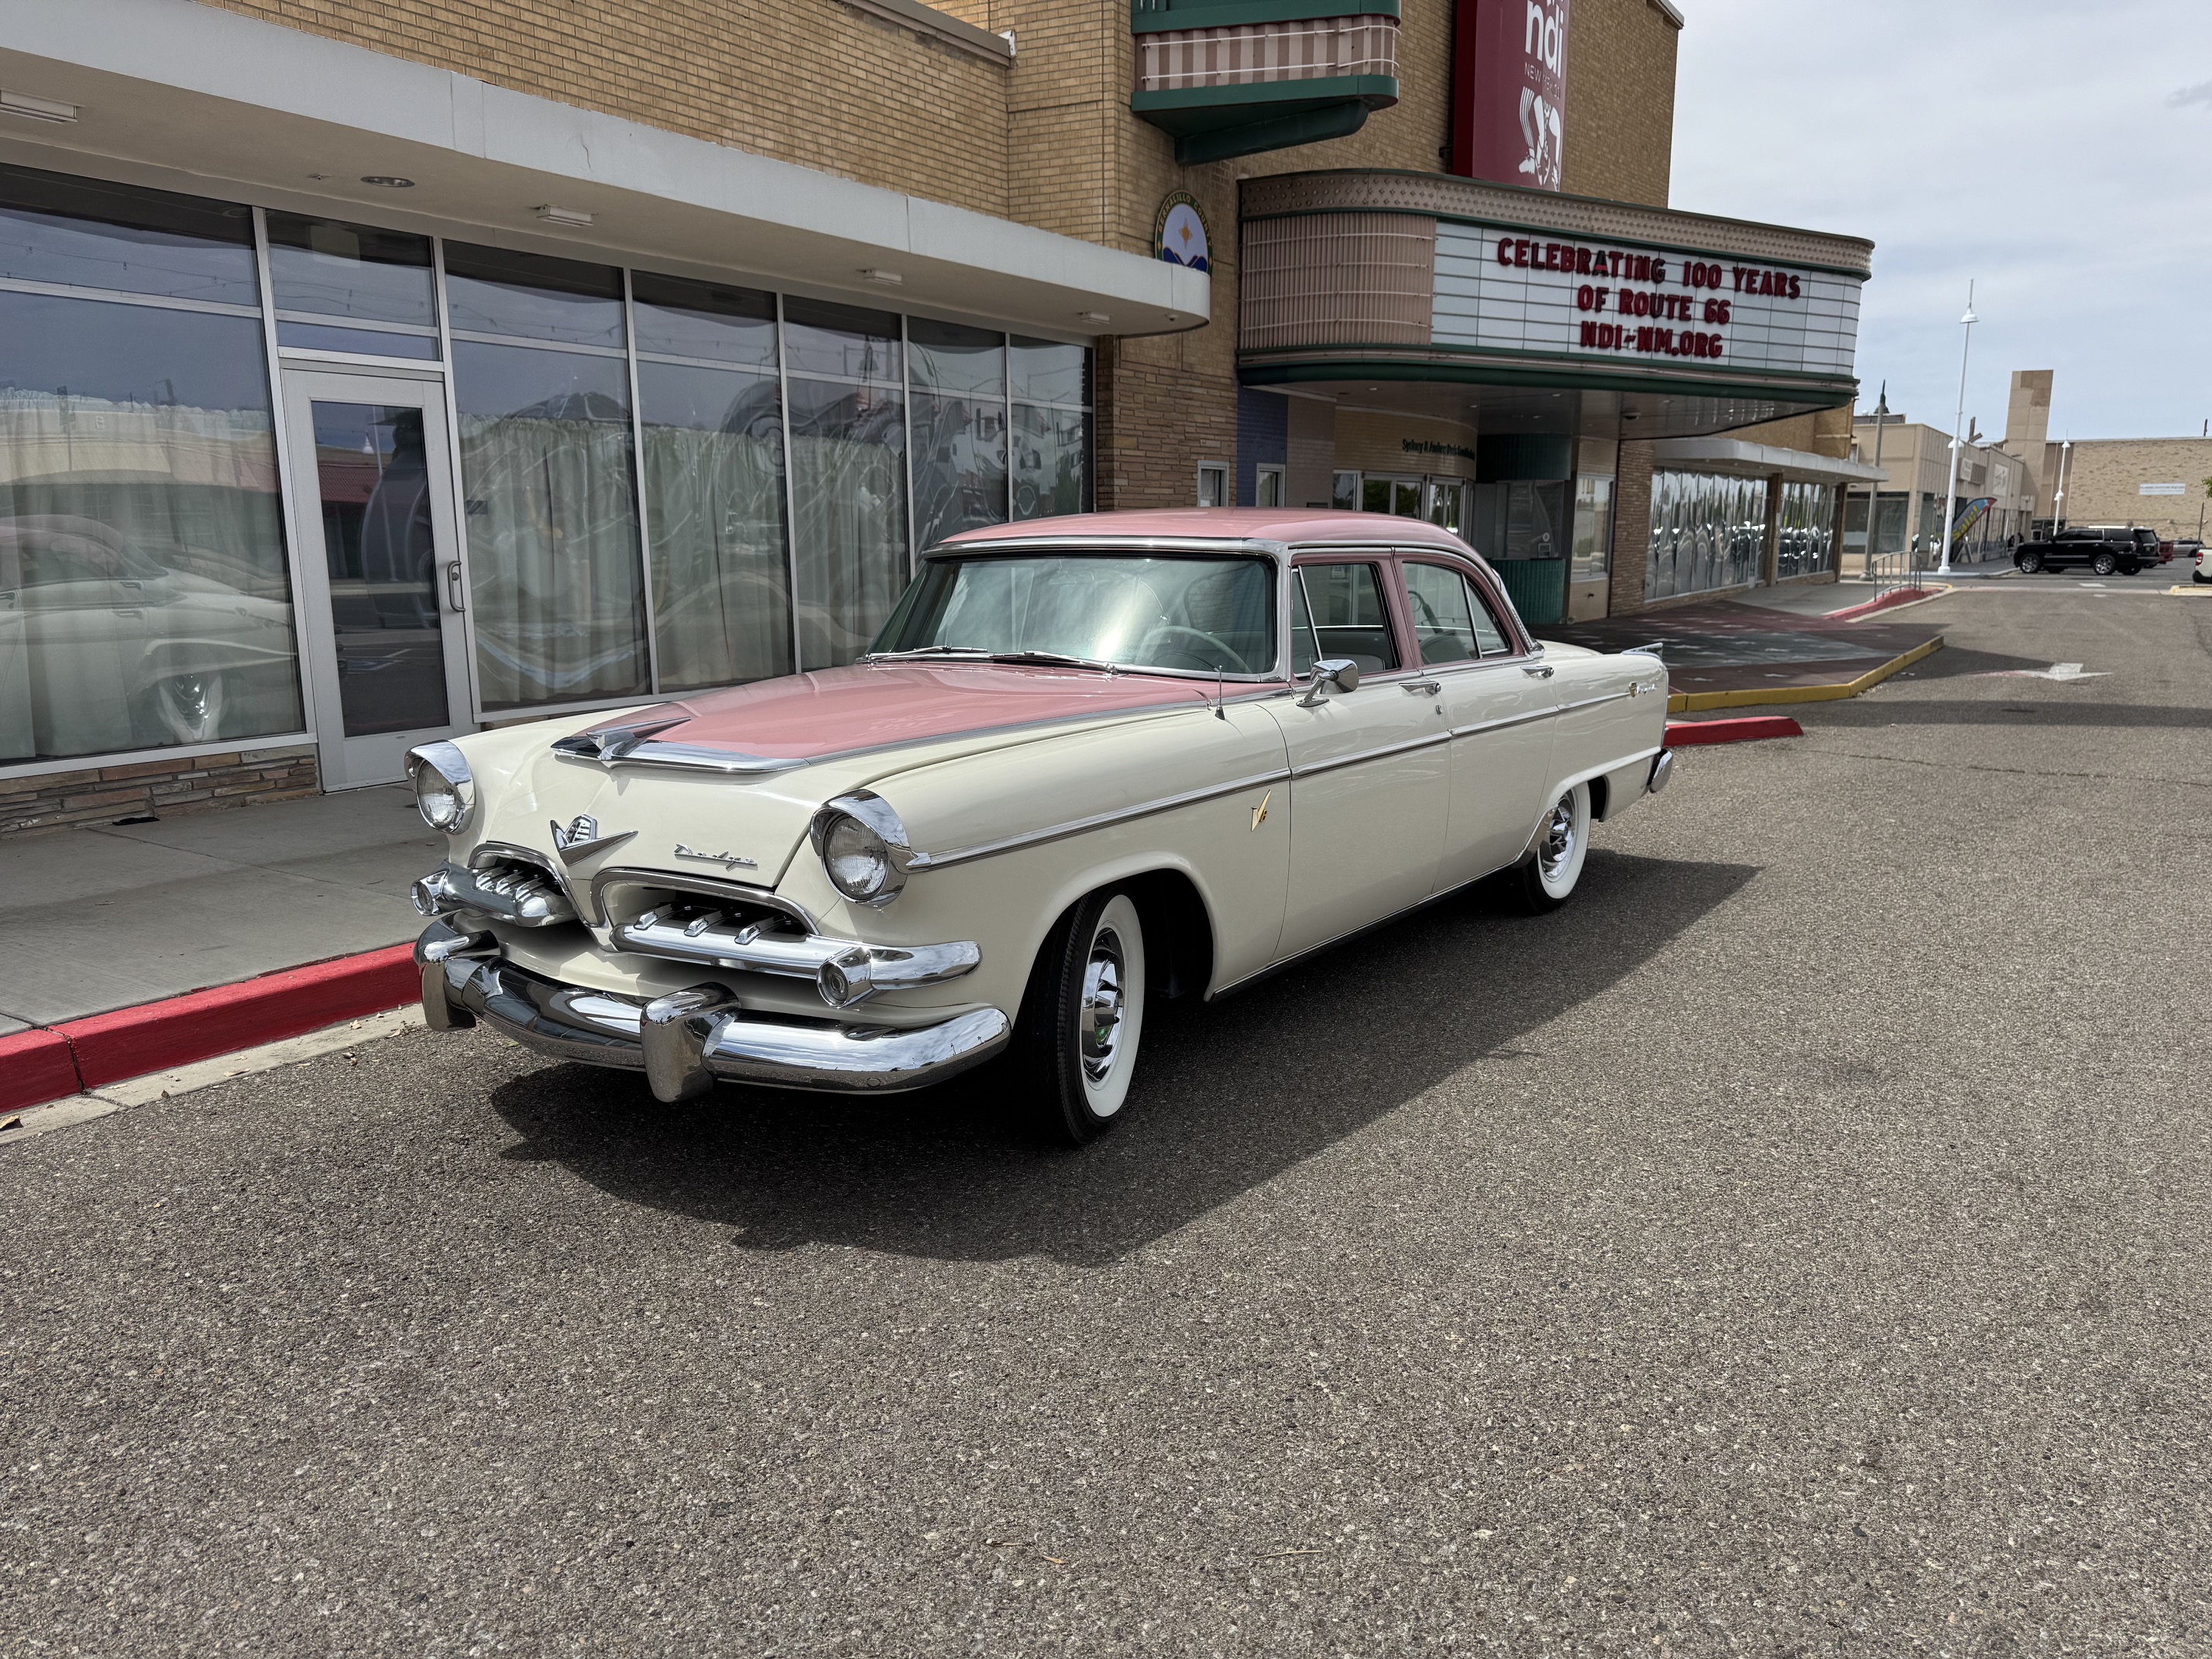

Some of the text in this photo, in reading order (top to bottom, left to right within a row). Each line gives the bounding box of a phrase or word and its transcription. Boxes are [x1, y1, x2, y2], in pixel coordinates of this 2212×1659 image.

[1525, 0, 1564, 79] ndi
[1524, 62, 1542, 83] NEW
[1159, 193, 1212, 246] BERNALILLO COUNTY
[1497, 238, 1801, 299] CELEBRATING 100 YEARS
[1578, 284, 1731, 325] OF ROUTE 66
[674, 843, 758, 872] Dodge
